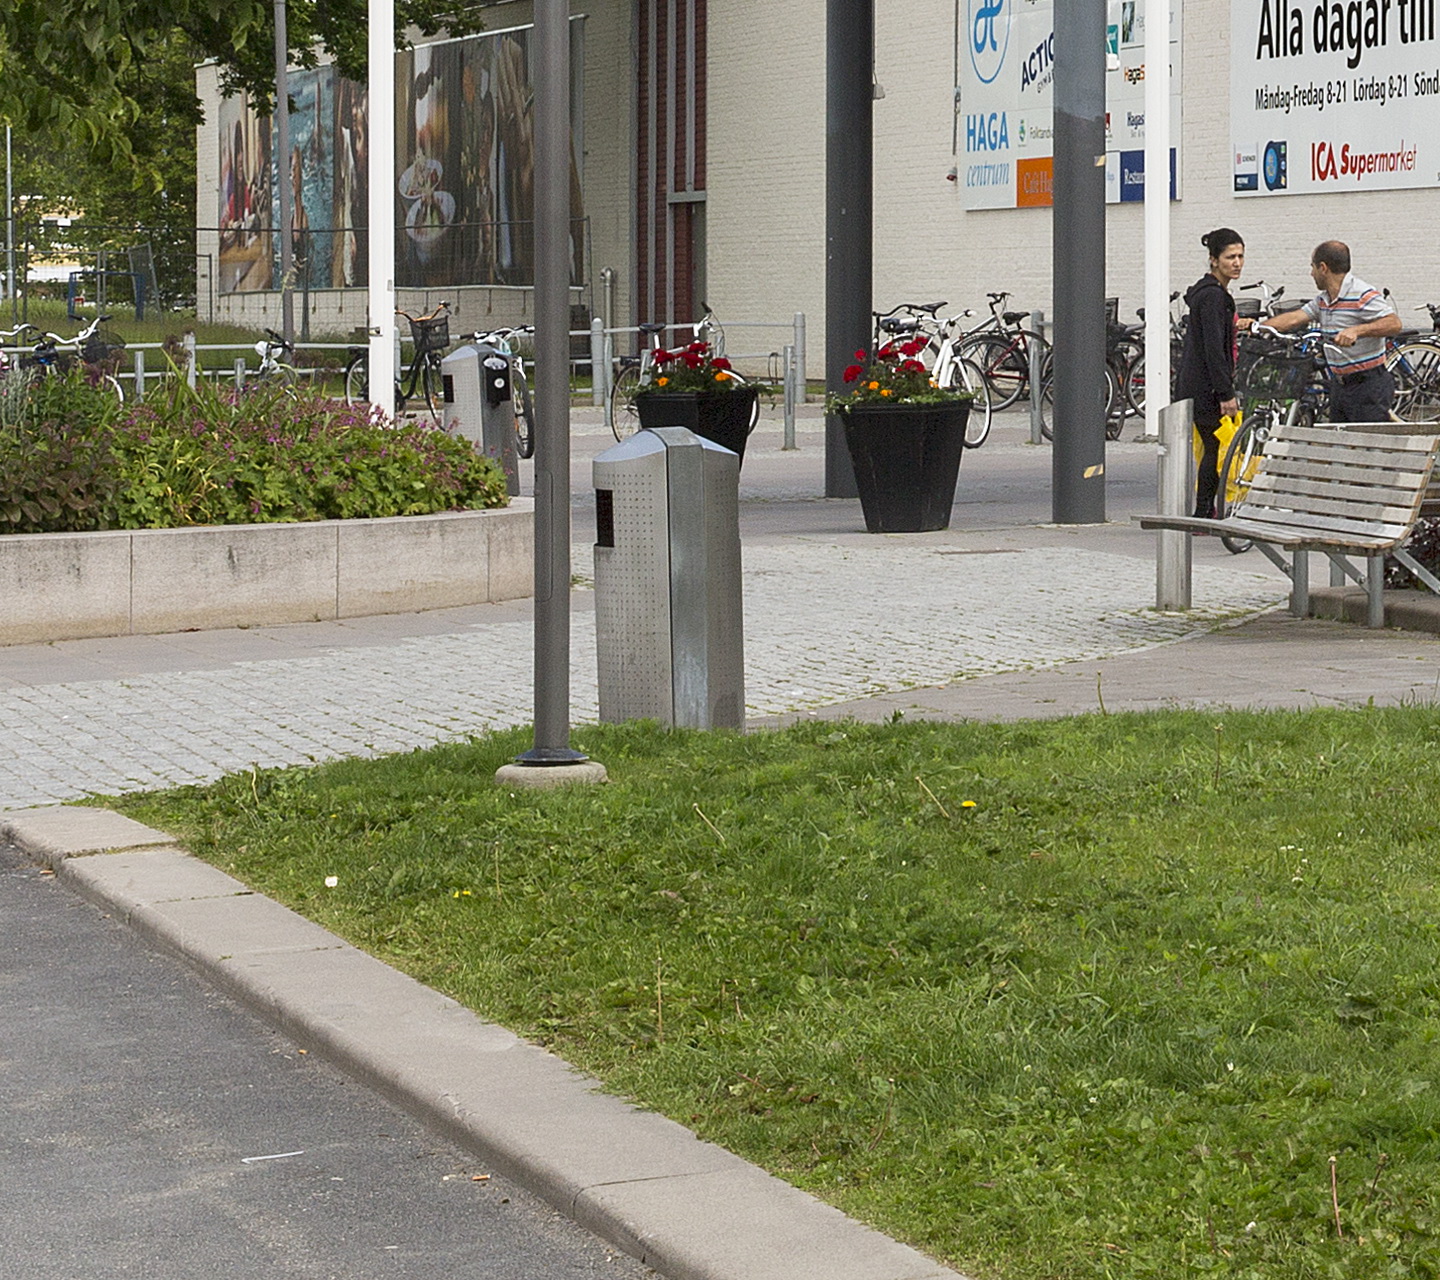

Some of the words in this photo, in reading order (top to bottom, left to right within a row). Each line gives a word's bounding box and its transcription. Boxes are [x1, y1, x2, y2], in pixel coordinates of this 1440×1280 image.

[1255, 81, 1324, 114] Måndag-Fredag
[1326, 80, 1347, 105] 8-21
[1353, 76, 1386, 106] Lördag
[1388, 74, 1408, 99] 8-21
[967, 111, 1009, 152] HAGA
[967, 161, 1009, 187] centrum
[1311, 141, 1339, 181] ICA
[1340, 139, 1417, 181] Supermarket
